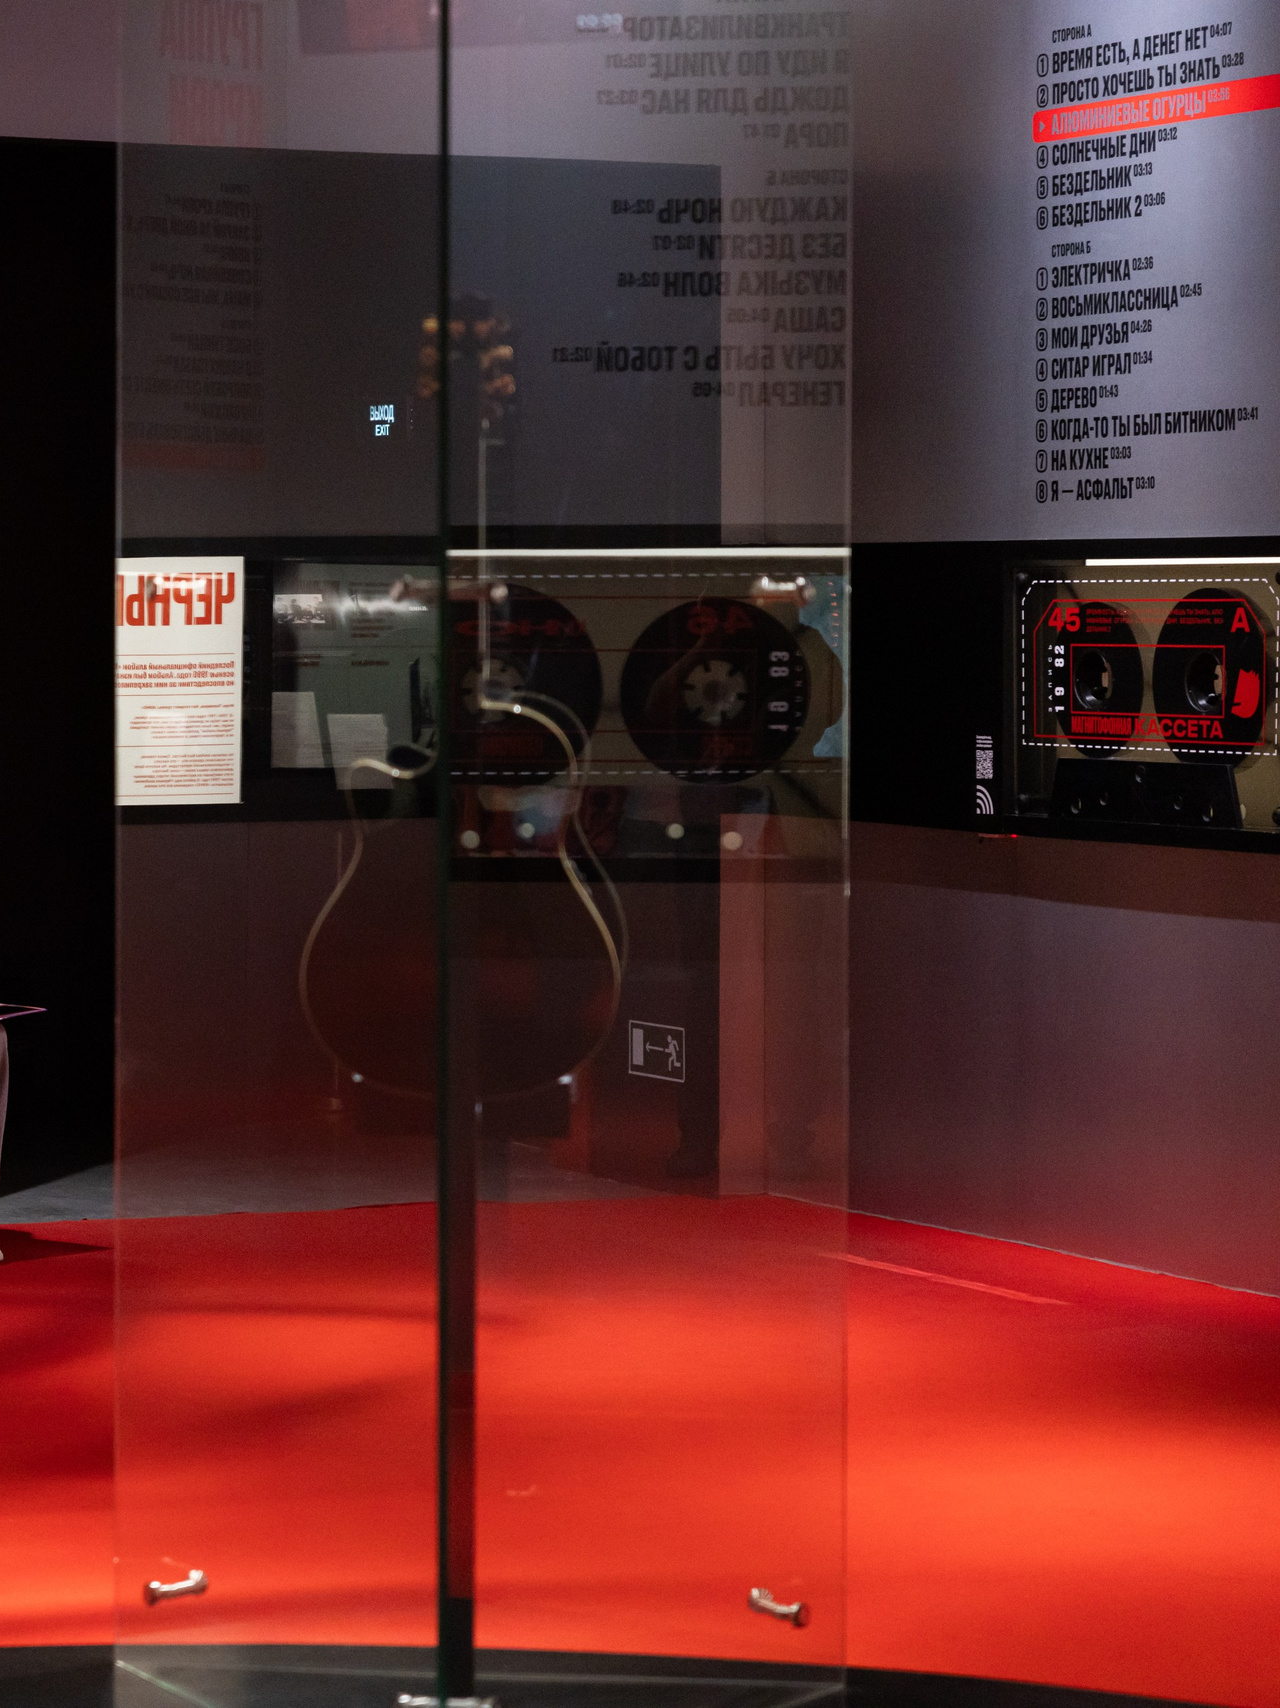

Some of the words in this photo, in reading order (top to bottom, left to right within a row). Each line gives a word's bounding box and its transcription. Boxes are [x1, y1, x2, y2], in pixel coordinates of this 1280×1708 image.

[1052, 25, 1086, 43] СТОРОНА
[1052, 47, 1092, 74] ВРЕМЯ
[1096, 41, 1129, 67] ЕСТЬ,
[1133, 38, 1140, 60] А
[1143, 31, 1182, 61] ДЕНЕГ
[1185, 26, 1208, 51] НЕТ
[1210, 22, 1232, 38] 04:07
[1052, 77, 1099, 105] ПРОСТО
[1103, 68, 1154, 98] ХОЧЕШЬ
[1157, 63, 1176, 88] ТЫ
[1180, 56, 1220, 84] ЗНАТЬ
[1222, 52, 1244, 68] 03:28
[1051, 100, 1149, 135] АЛЮМИНИЕВЫЕ
[1153, 91, 1206, 120] ОГУРЦЫ
[1052, 135, 1127, 166] СОЛНЕЧНЫЕ
[1129, 130, 1156, 158] ДНИ
[1158, 127, 1177, 142] 03:12
[1052, 165, 1132, 196] БЕЗДЕЛЬНИК
[1134, 162, 1152, 177] 03:13
[1052, 196, 1131, 227] БЕЗДЕЛЬНИК
[1134, 195, 1142, 217] 2
[1144, 192, 1165, 206] 03:06
[1051, 242, 1085, 258] СТОРОНА
[1051, 259, 1130, 288] ЭЛЕКТРИЧКА
[1132, 256, 1153, 271] 02:36
[1051, 285, 1178, 319] ВОСЬМИКЛАССНИЦА
[1180, 283, 1202, 298] 02:45
[1051, 326, 1078, 349] МОИ
[1080, 321, 1129, 350] ДРУЗЬЯ
[1130, 319, 1152, 334] 04:26
[1051, 355, 1089, 380] СИТАР
[1092, 352, 1131, 377] ИГРАЛ
[1133, 351, 1152, 365] 01:34
[370, 405, 394, 423] ВЫХОД
[1051, 386, 1097, 413] ДЕРЕВО
[1099, 385, 1118, 399] 01:43
[375, 424, 390, 436] EXIT
[1051, 416, 1108, 442] КОГДА-ТО
[1112, 415, 1130, 437] ТЫ
[1133, 413, 1161, 436] БЫЛ
[1164, 408, 1236, 435] БИТНИКОМ
[1237, 407, 1259, 421] 03:41
[1051, 449, 1067, 471] НА
[1070, 447, 1109, 470] КУХНЕ
[1110, 446, 1131, 459] 03:03
[1051, 480, 1058, 501] Я
[1076, 477, 1134, 500] АСФАЛЬТ
[1135, 476, 1155, 490] 03:10
[1048, 607, 1080, 632] 45
[1134, 718, 1223, 739] КАССЕТА
